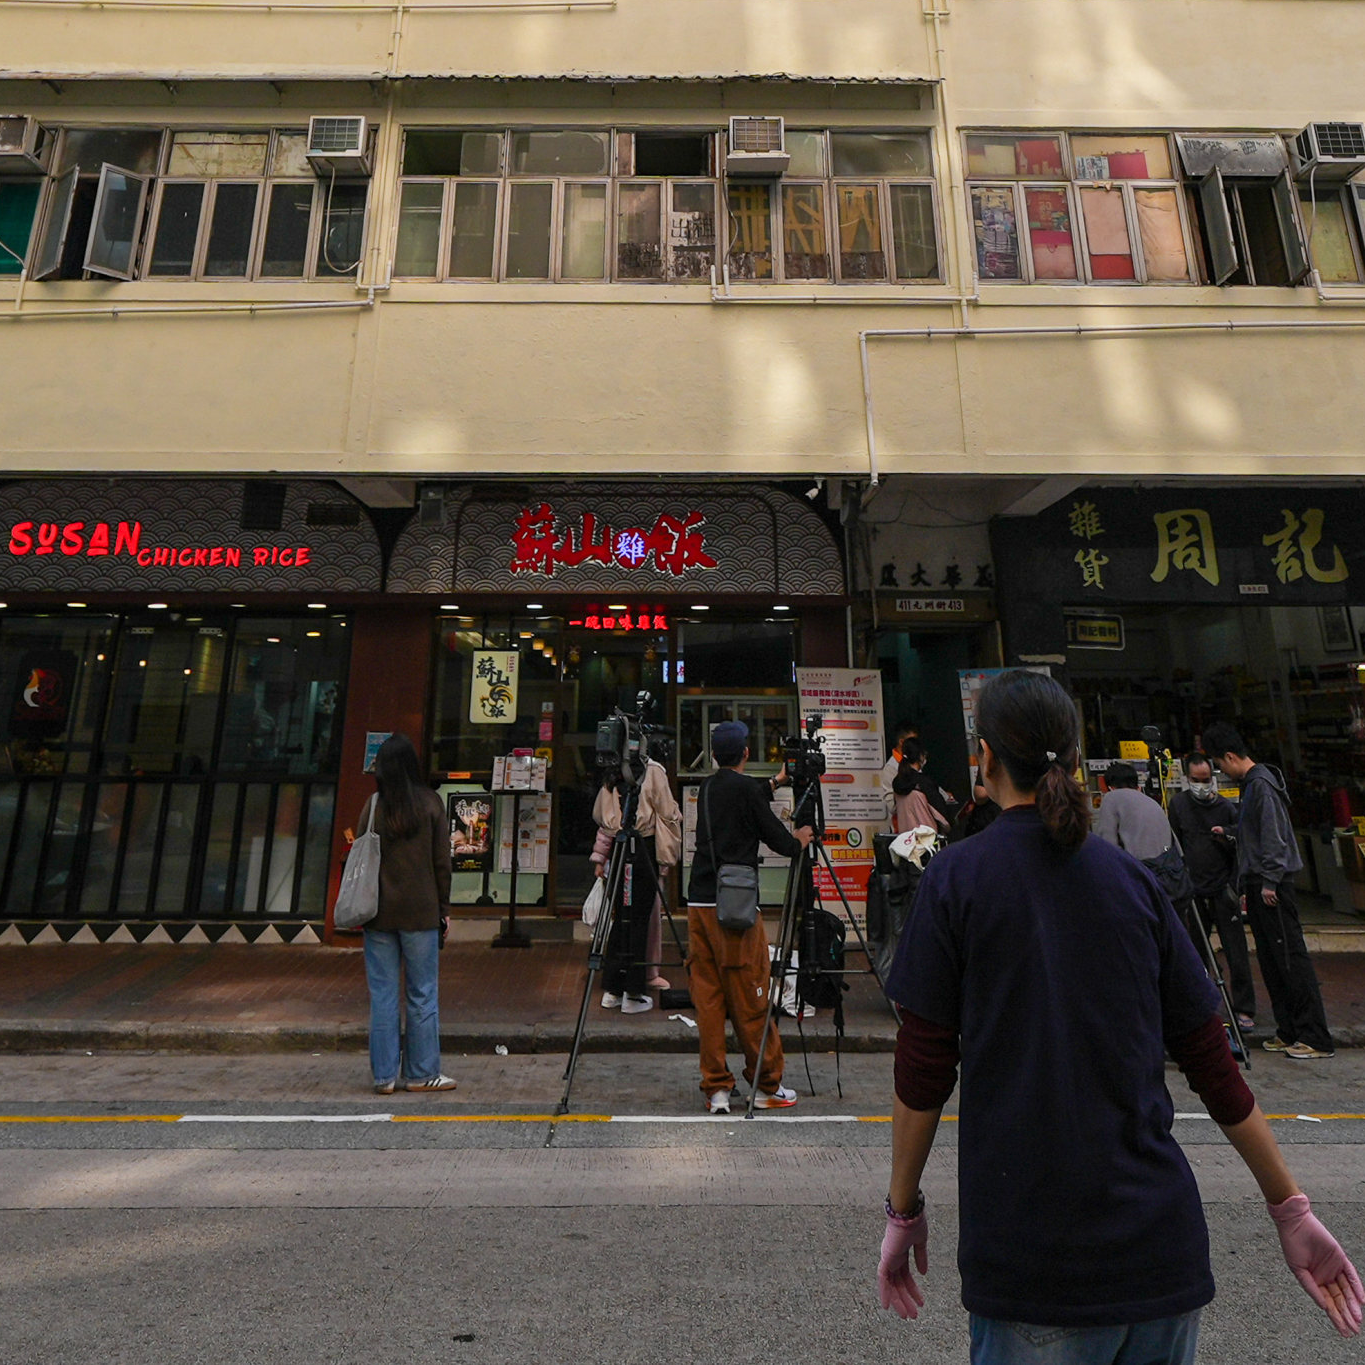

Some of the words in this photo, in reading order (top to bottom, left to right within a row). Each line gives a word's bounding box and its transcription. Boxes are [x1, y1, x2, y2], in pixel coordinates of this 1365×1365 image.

[9, 521, 142, 556] SUSAN
[137, 546, 241, 568] CHICKEN
[254, 546, 312, 568] RICE
[510, 502, 718, 578] 蘇山雞飯
[1068, 500, 1109, 590] 雜貨
[1150, 508, 1349, 586] 周記
